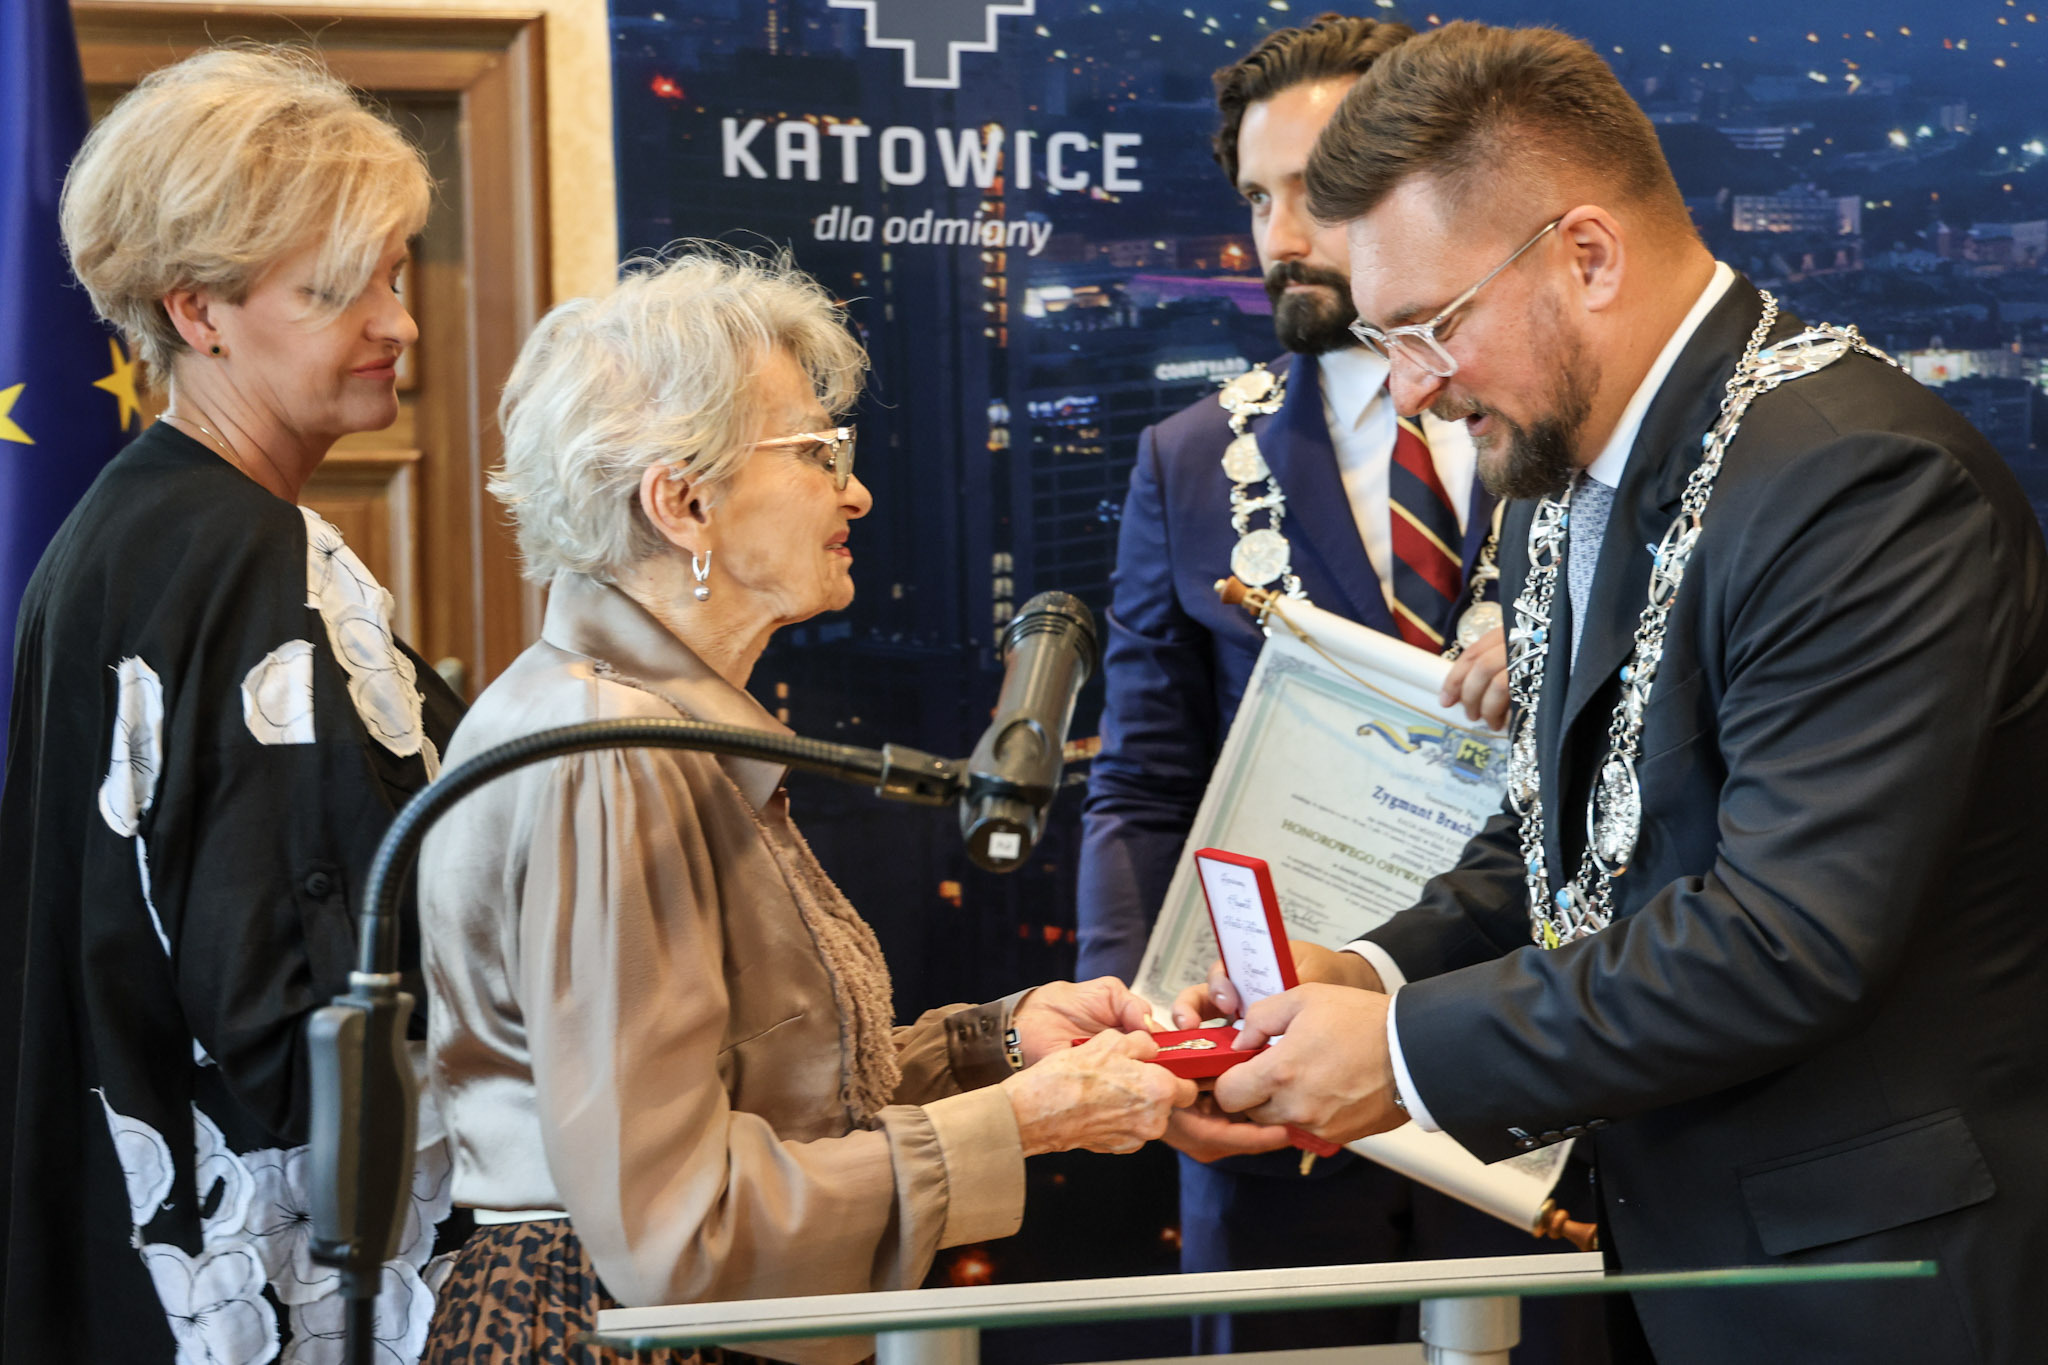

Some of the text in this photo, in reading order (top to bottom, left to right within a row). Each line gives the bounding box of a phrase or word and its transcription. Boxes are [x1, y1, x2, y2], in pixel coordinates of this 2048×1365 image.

[721, 116, 1143, 192] KATOWICE
[813, 205, 1053, 257] dla odmiany
[1372, 784, 1432, 820] Zygmunt
[1281, 818, 1376, 865] HONOROWEGO
